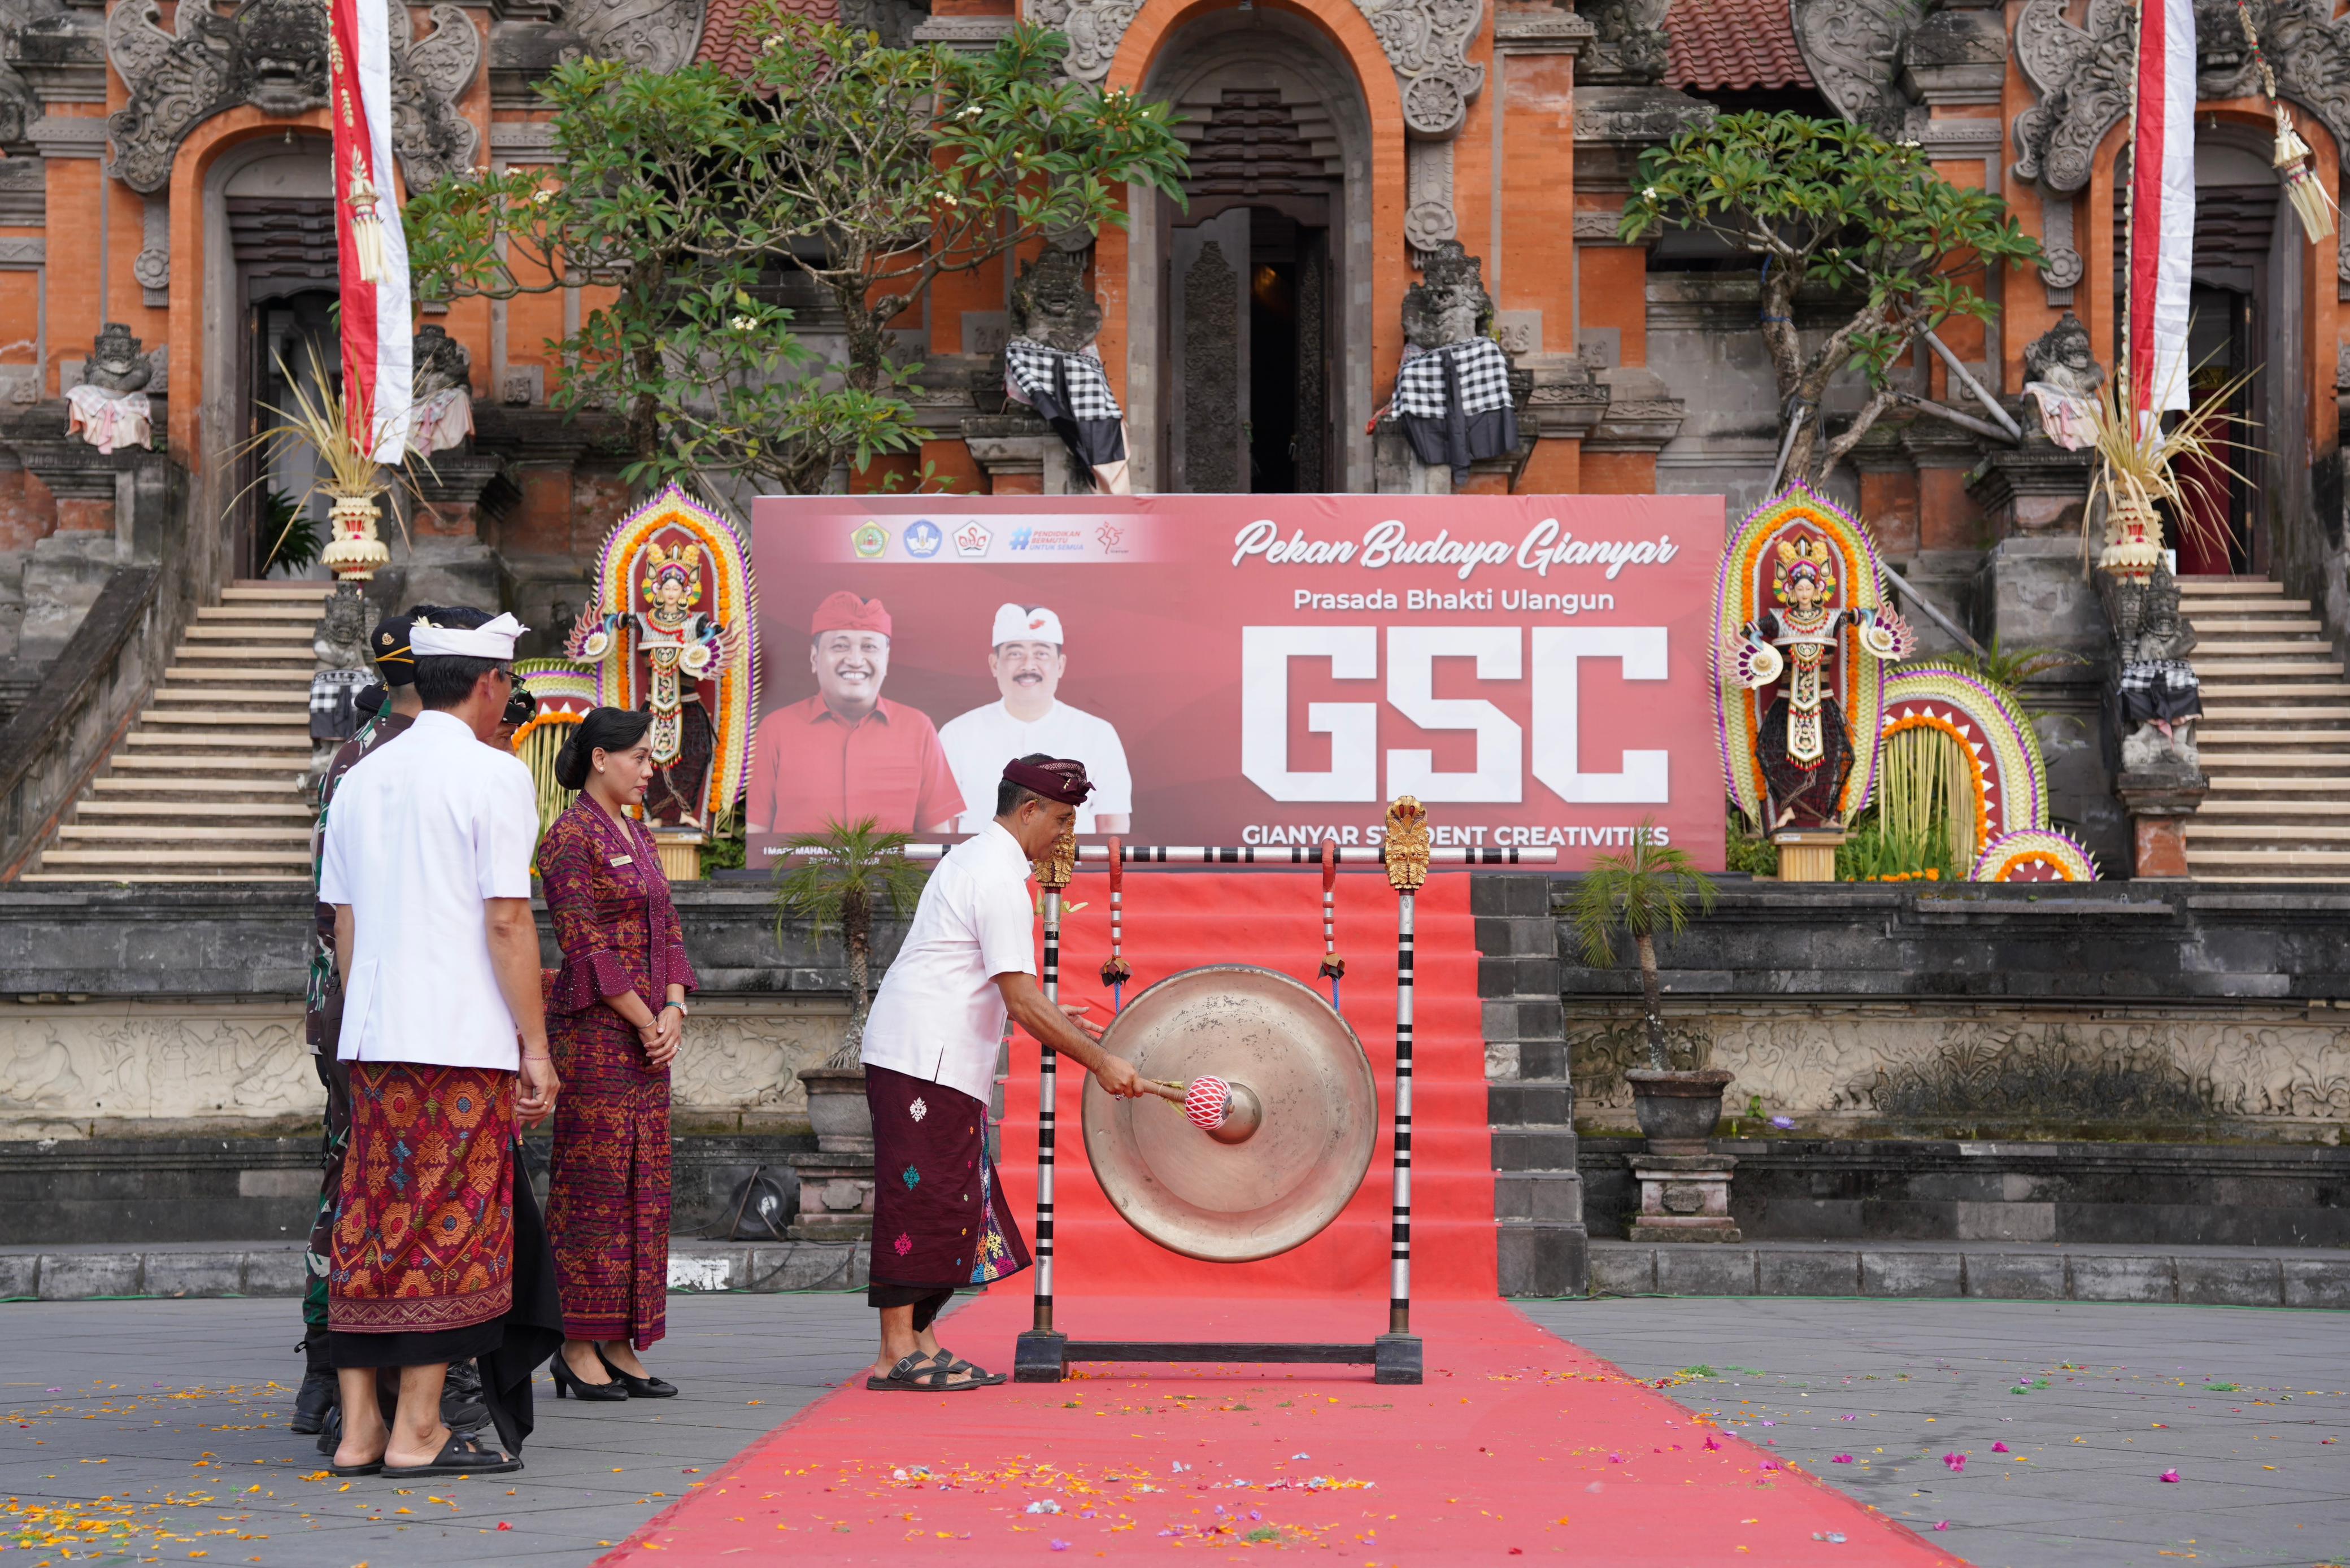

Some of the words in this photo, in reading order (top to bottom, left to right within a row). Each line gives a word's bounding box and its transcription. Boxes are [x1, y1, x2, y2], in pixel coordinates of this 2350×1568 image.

[1232, 519, 1359, 567] Pekan
[1360, 520, 1515, 580] Budaya
[1517, 518, 1679, 580] Gianyar
[1294, 588, 1398, 610] Prasada
[1407, 588, 1493, 610] Bhakti
[1501, 589, 1614, 615] Ulangun
[1242, 626, 1669, 803] GSC
[1242, 825, 1359, 845] GIANYAR
[1365, 825, 1487, 846] SENT
